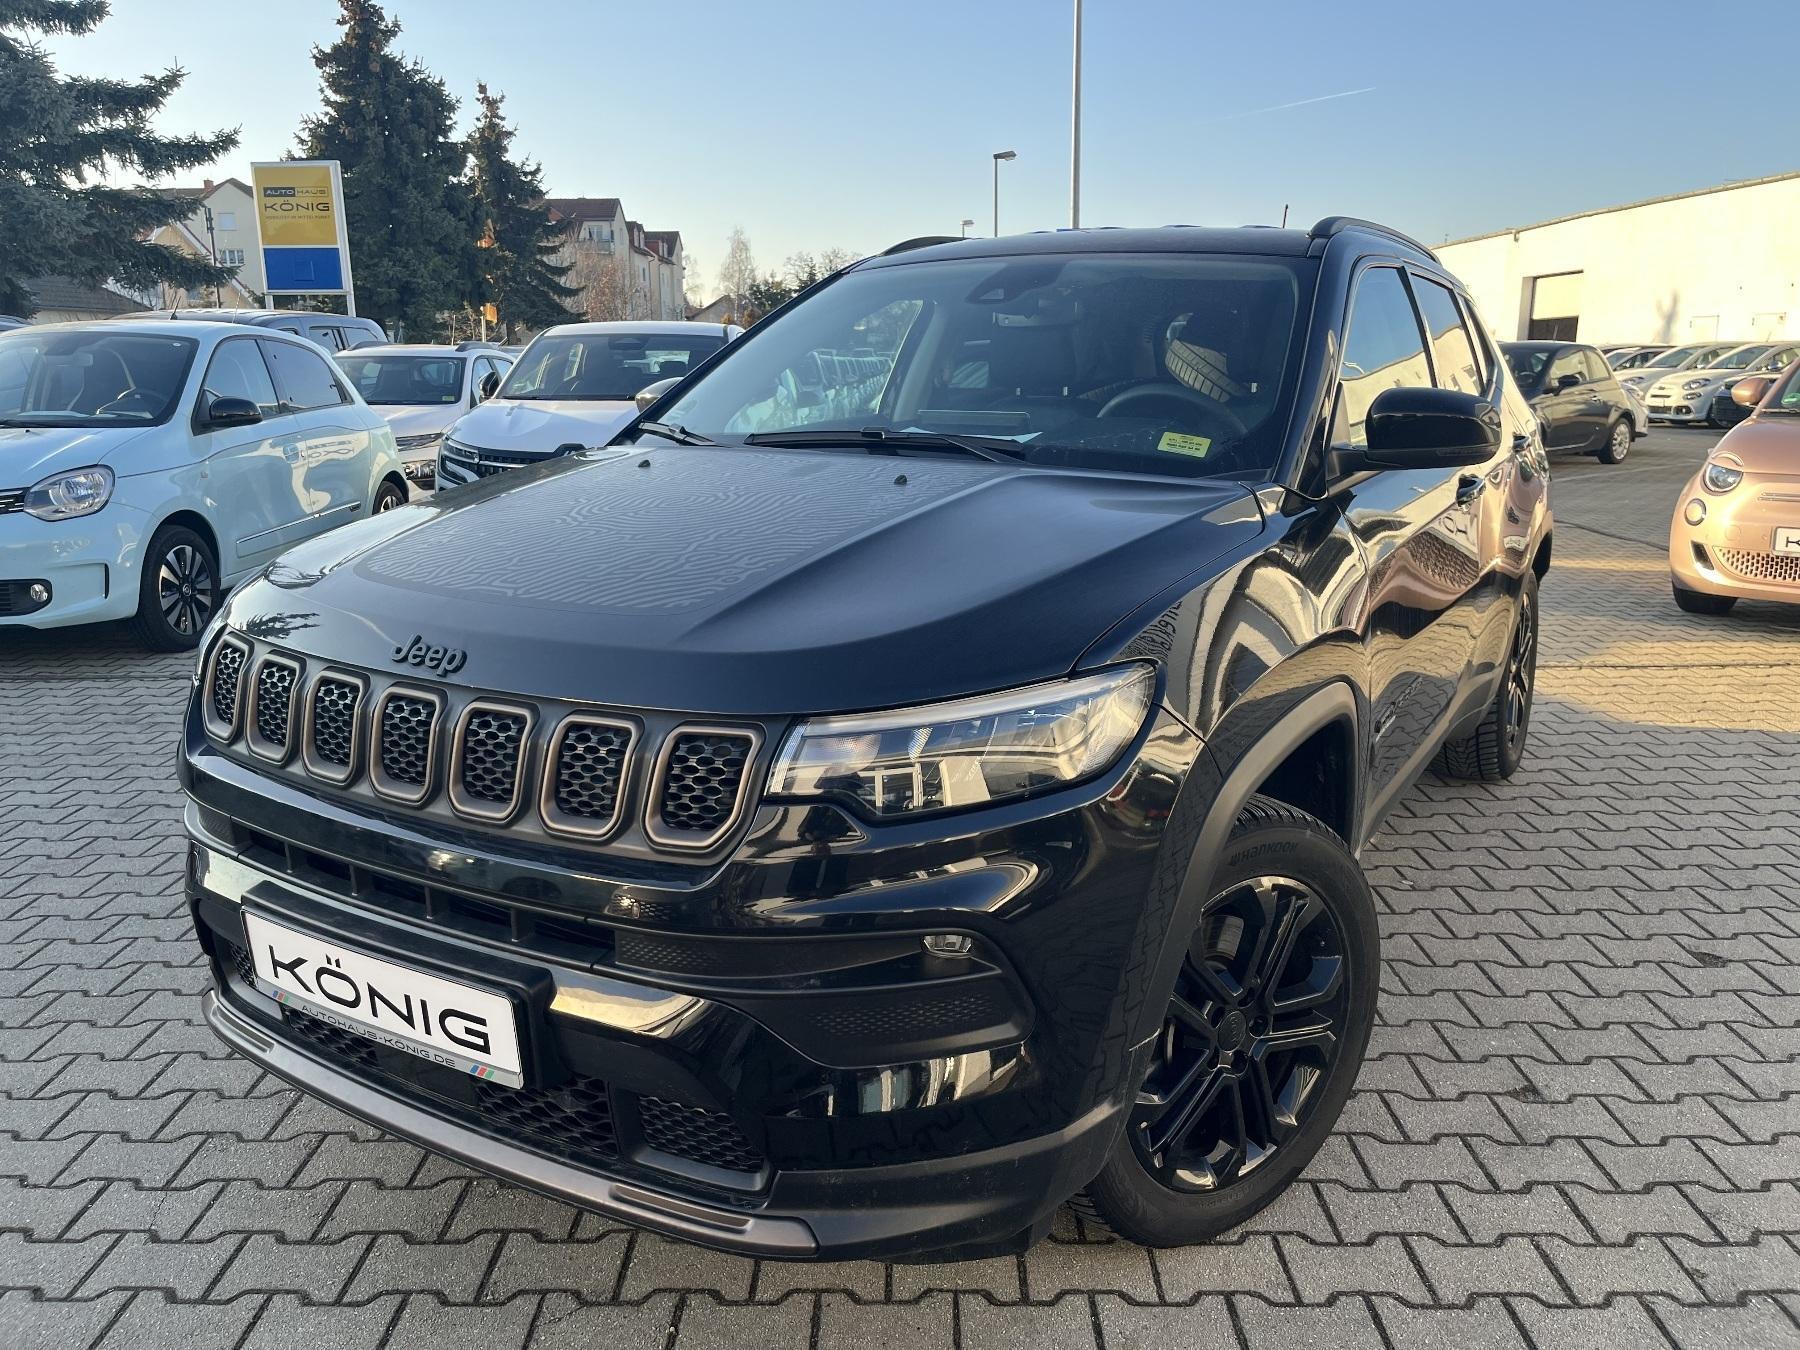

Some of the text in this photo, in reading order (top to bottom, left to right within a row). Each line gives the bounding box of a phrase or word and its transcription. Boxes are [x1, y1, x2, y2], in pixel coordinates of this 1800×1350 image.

[264, 199, 330, 212] KÖNIG
[391, 633, 467, 678] Jeep
[268, 944, 491, 1056] KÖNIG
